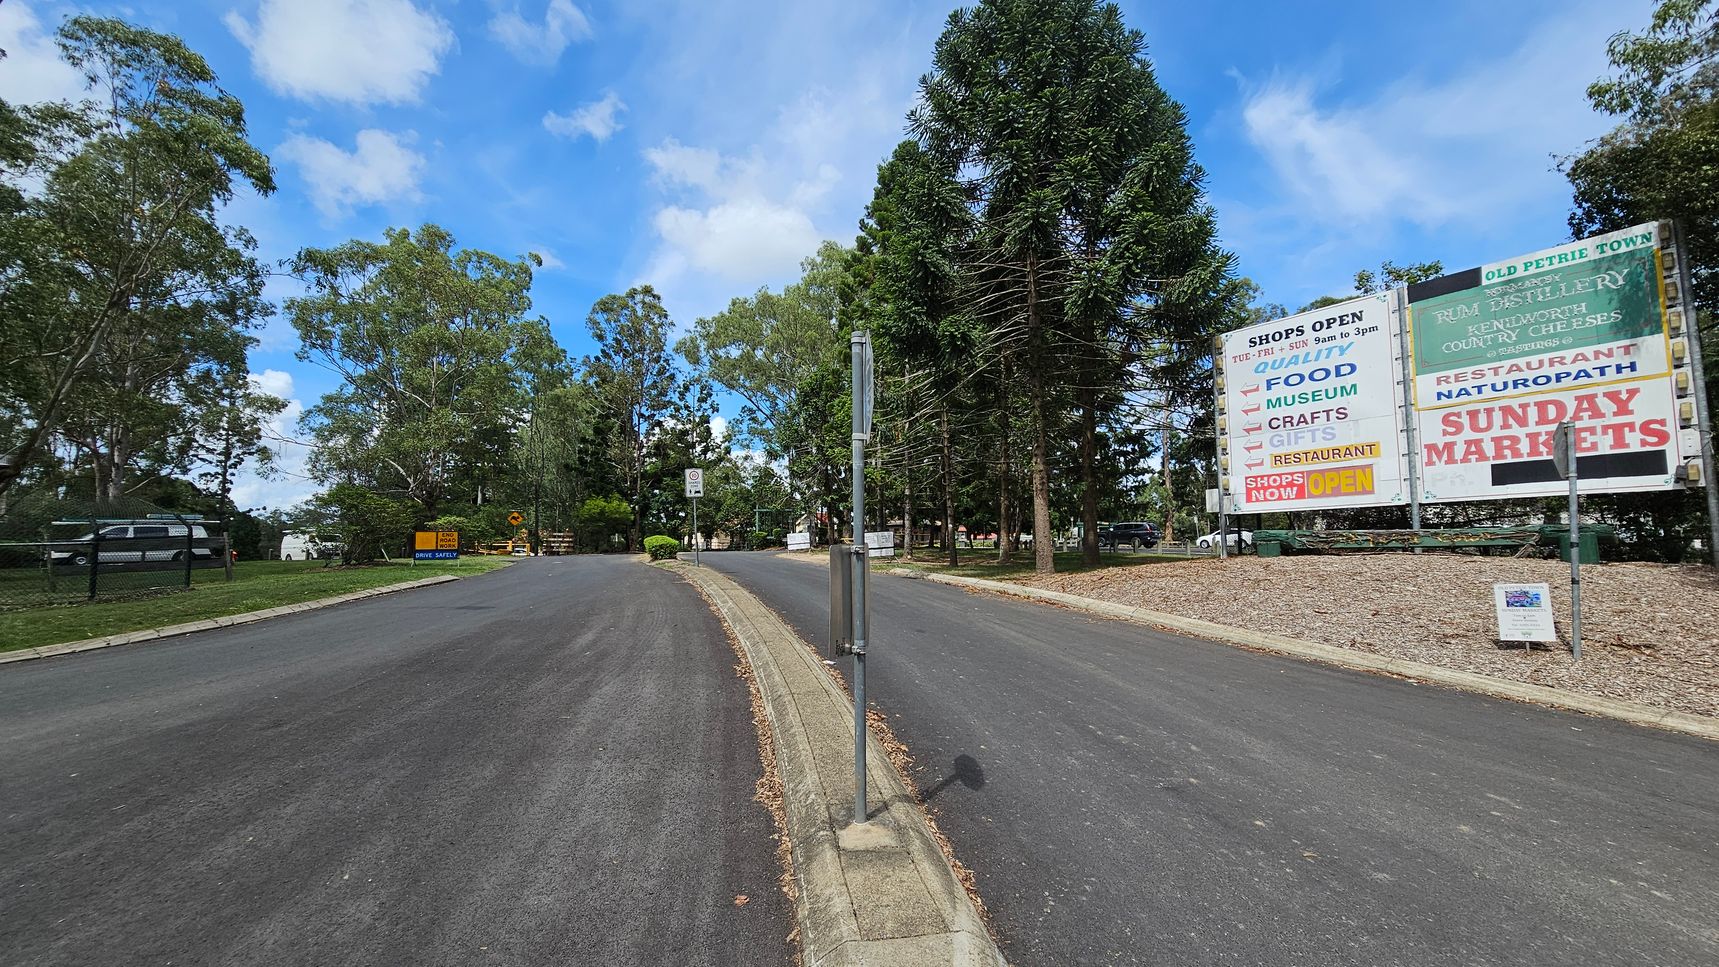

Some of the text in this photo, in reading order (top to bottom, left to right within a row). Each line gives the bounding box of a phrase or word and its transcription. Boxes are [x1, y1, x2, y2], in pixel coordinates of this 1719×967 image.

[1485, 232, 1653, 281] OLD PETRIE TOWN
[1432, 269, 1630, 325] RUM DISTILLERY
[1248, 310, 1364, 349] SHOPS OPEN
[1442, 310, 1622, 354] COUNTRY CHEESES
[1467, 302, 1587, 336] KENILWORTH
[1288, 339, 1309, 351] SUN
[1313, 334, 1337, 345] 9am
[1340, 331, 1350, 340] to
[1354, 325, 1379, 338] 3pm
[1498, 338, 1560, 355] TASTINGS
[1253, 341, 1355, 374] QUALITY
[1436, 343, 1638, 386] RESTAURANT
[1265, 362, 1358, 392] FOOD
[1436, 361, 1638, 401] NATUROPATH
[1266, 383, 1358, 410] MUSEUM
[1268, 406, 1349, 430] CRAFTS
[1441, 387, 1641, 437] SUNDAY
[1269, 426, 1337, 449] GIFTS
[1273, 444, 1376, 466] RESTAURANT
[1246, 472, 1304, 488] SHOPS
[1251, 487, 1297, 501] NOW
[1308, 468, 1373, 495] OPEN
